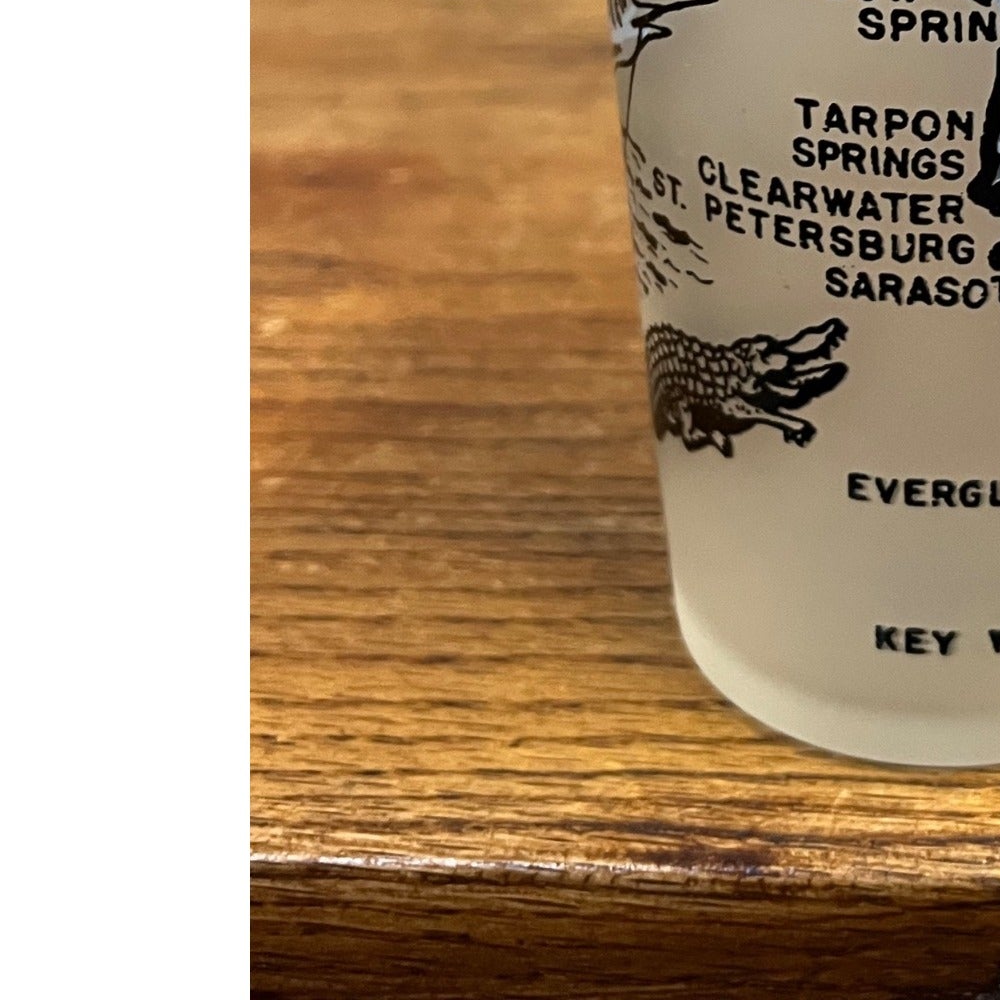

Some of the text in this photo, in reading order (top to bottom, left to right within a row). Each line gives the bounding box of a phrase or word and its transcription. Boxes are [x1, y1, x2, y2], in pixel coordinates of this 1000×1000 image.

[794, 97, 974, 142] TARPON
[792, 137, 966, 181] SPRINGS
[698, 154, 965, 225] CLEARWATER
[653, 166, 975, 265] ST. PETERSBURG
[875, 624, 957, 656] KEY
